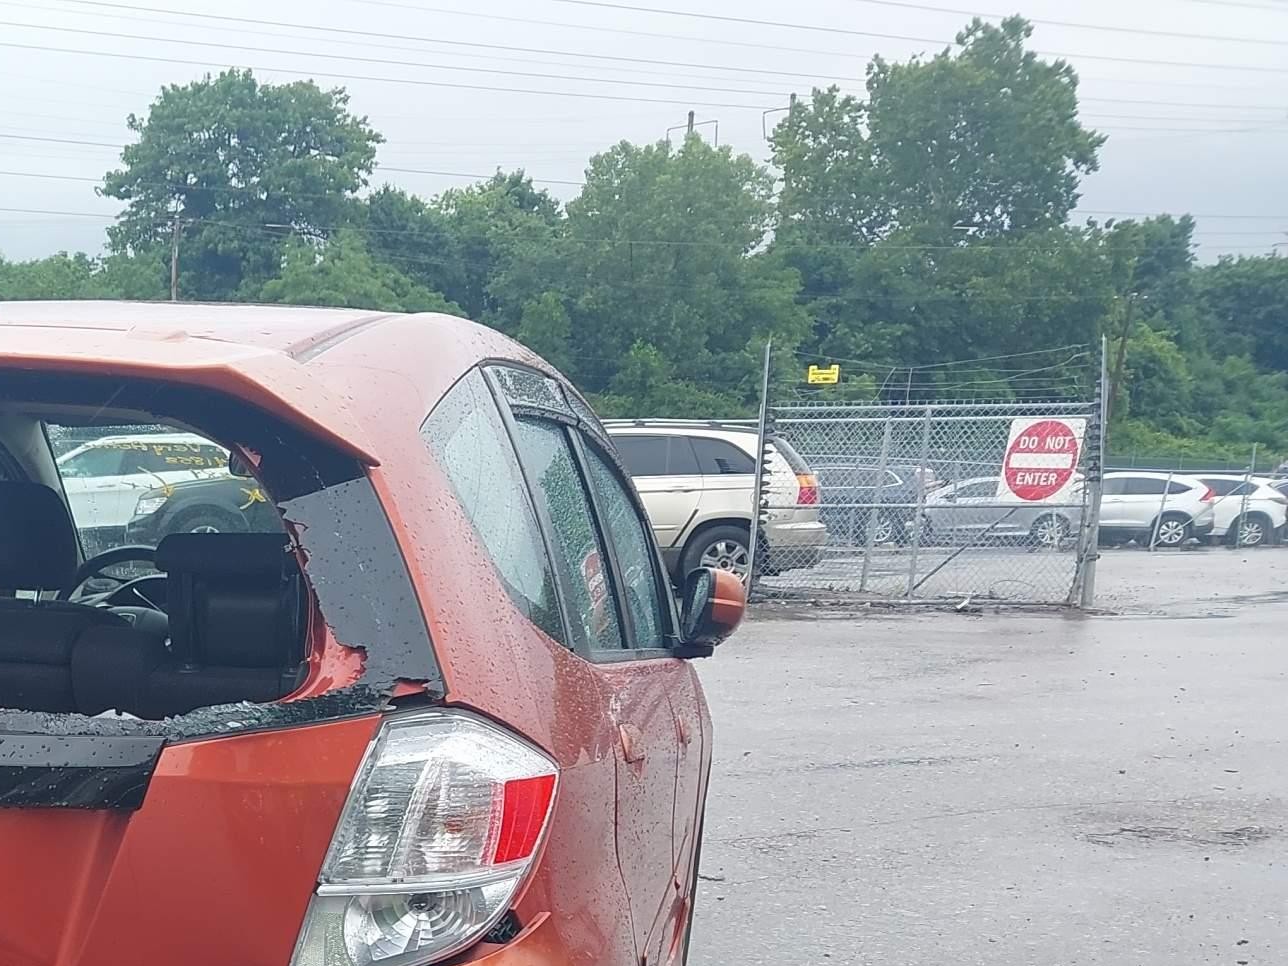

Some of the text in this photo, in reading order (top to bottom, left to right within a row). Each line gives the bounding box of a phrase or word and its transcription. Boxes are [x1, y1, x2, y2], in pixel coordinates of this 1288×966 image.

[1019, 436, 1073, 450] DO NOT
[1016, 472, 1058, 486] ENTER
